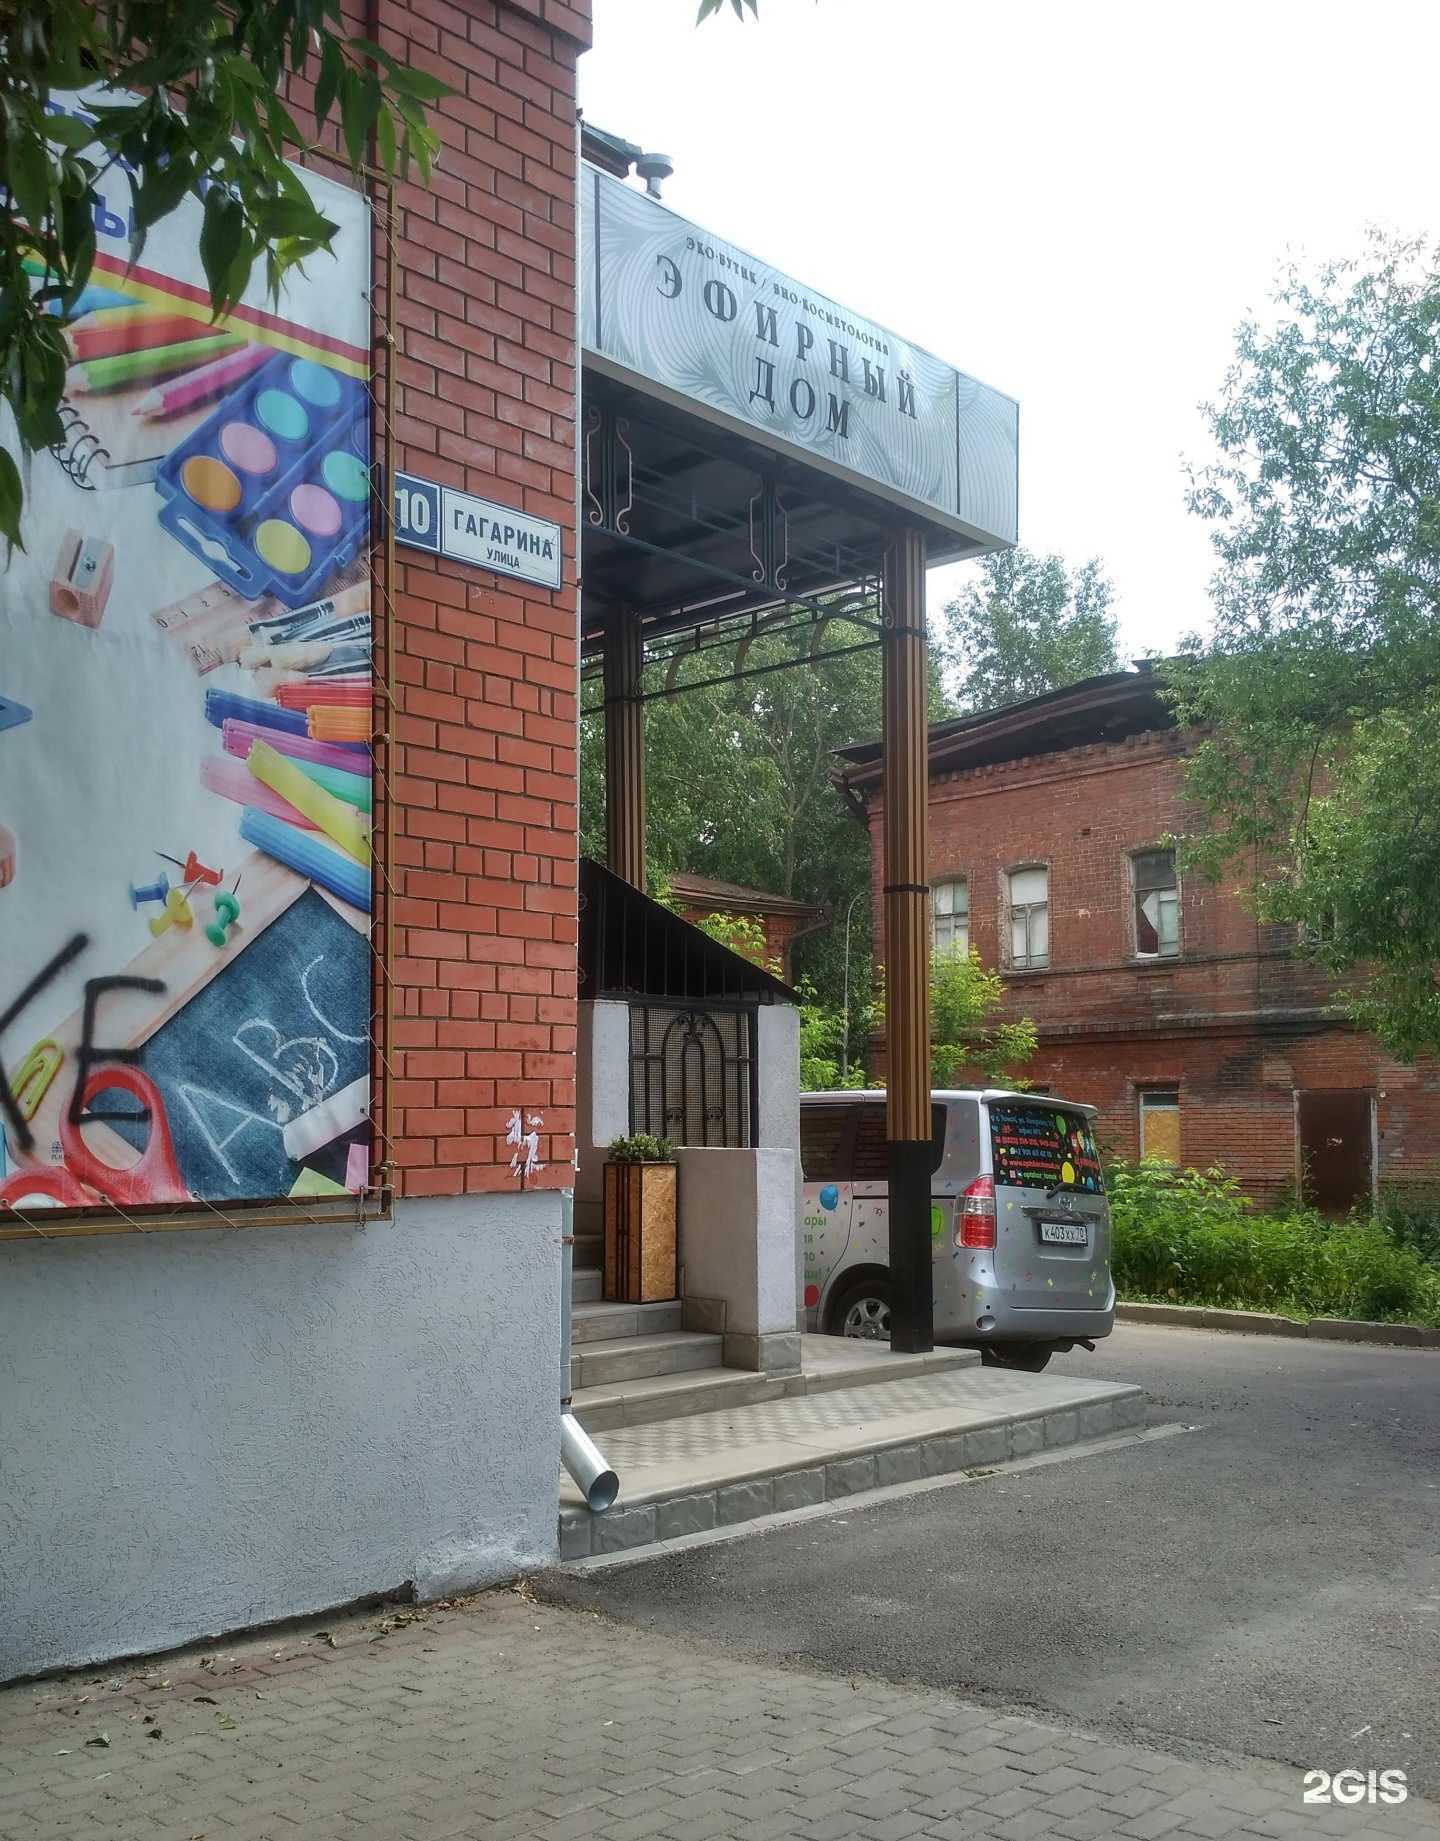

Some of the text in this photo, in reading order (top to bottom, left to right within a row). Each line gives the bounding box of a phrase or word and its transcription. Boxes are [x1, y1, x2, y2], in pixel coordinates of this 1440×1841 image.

[656, 254, 919, 420] ЭФИРНЫЙ
[749, 356, 850, 440] ДОМ
[395, 488, 430, 534] 10
[454, 509, 554, 561] ГАГАРИНА
[486, 547, 520, 569] УЛИЦА
